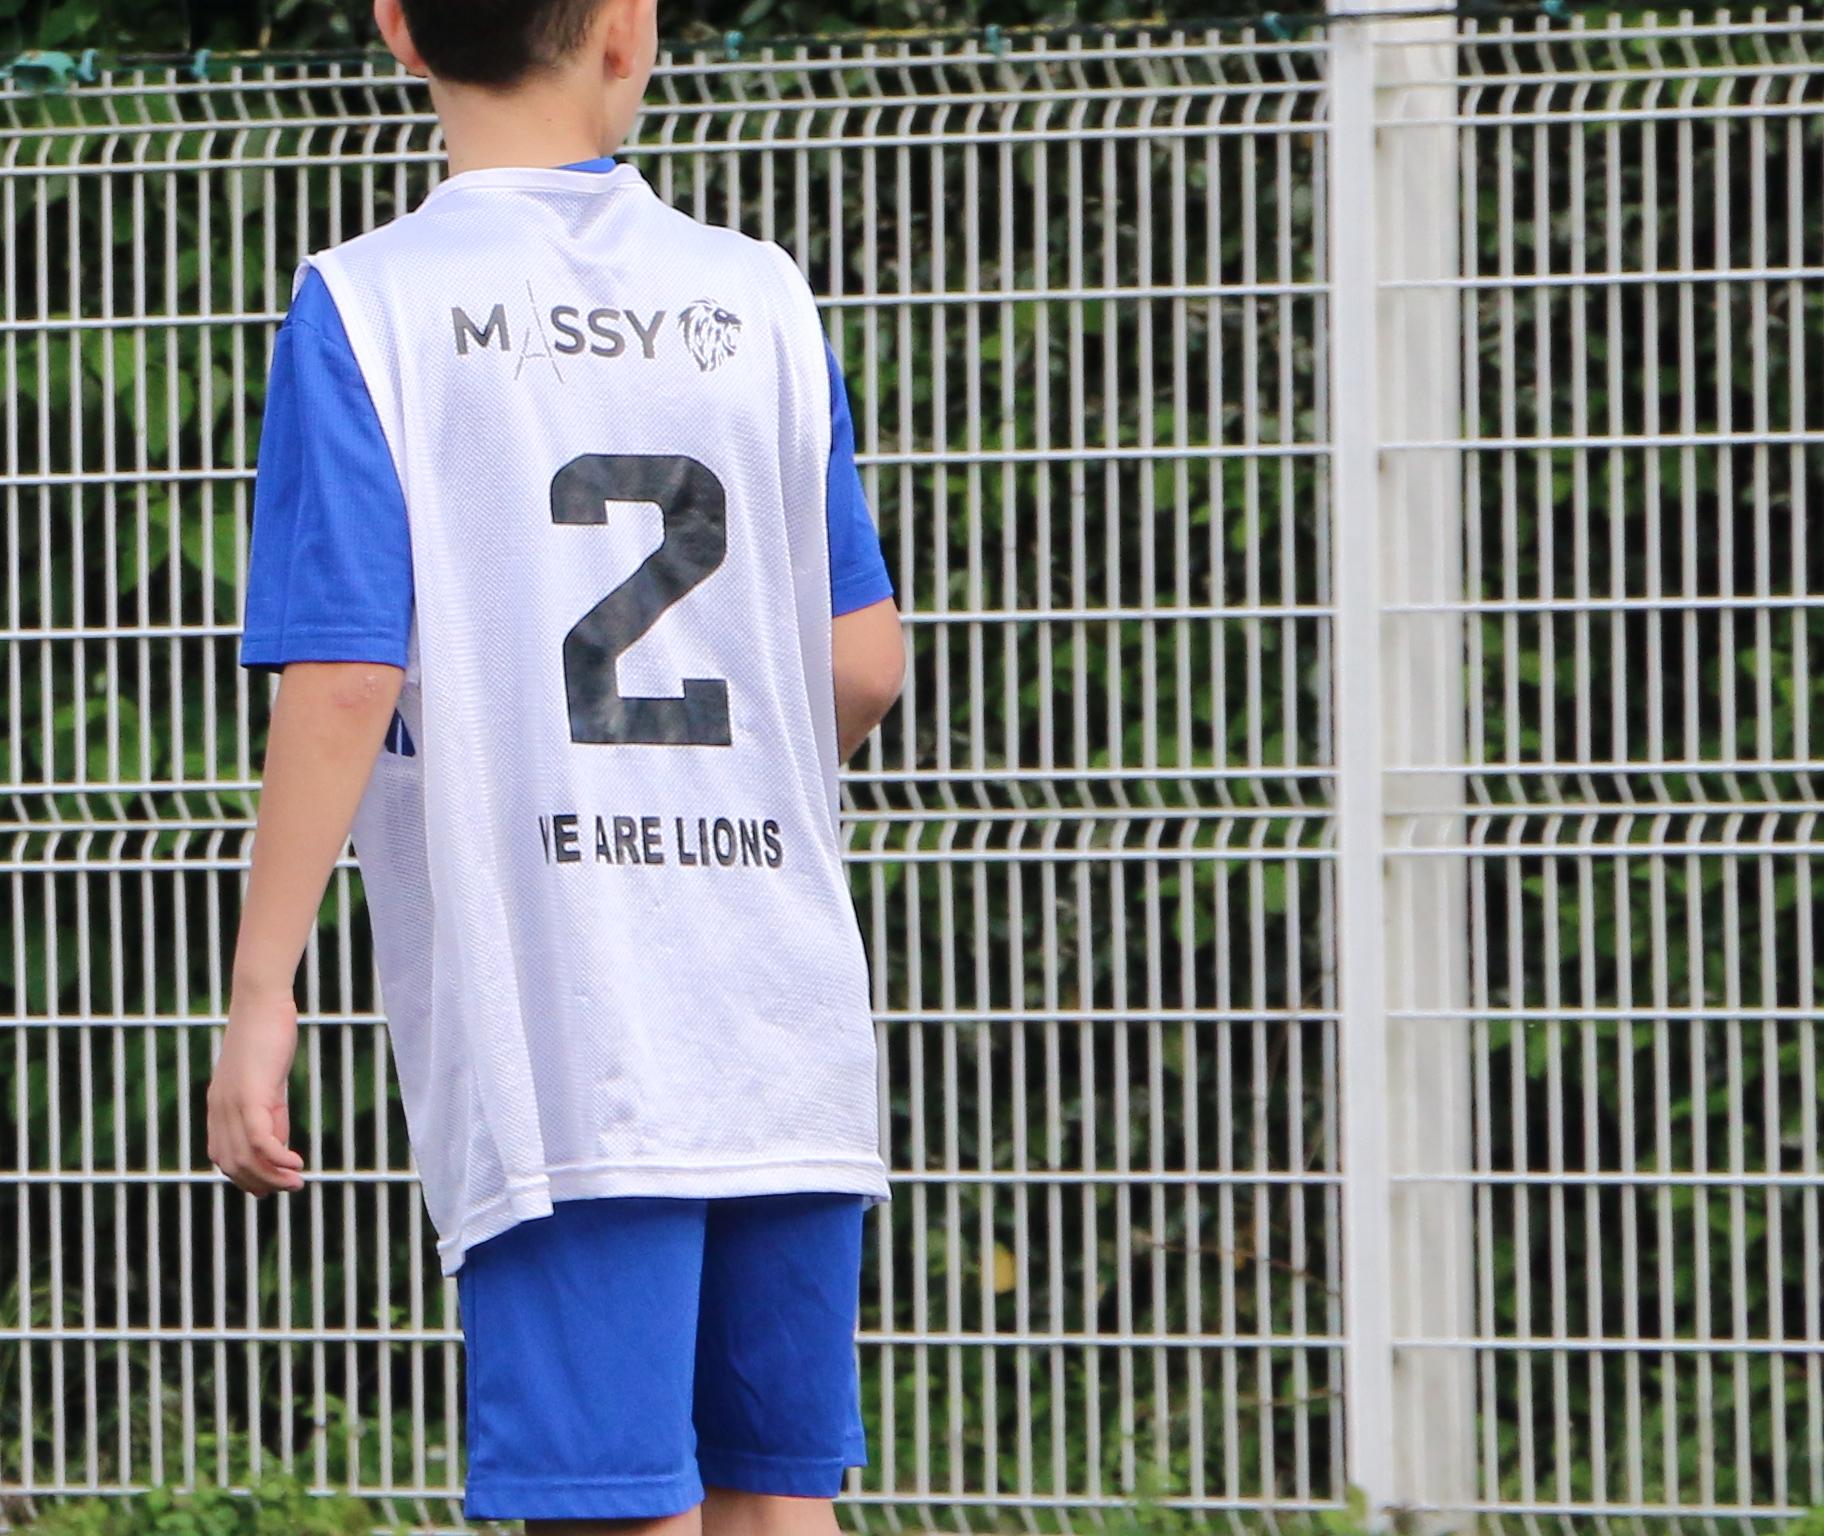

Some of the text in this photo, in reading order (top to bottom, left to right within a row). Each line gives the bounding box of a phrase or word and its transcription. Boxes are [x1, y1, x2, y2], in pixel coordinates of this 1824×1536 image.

[451, 280, 667, 383] MASSY
[551, 454, 731, 746] 2
[595, 815, 664, 865] ARE
[675, 817, 784, 869] LIONS
